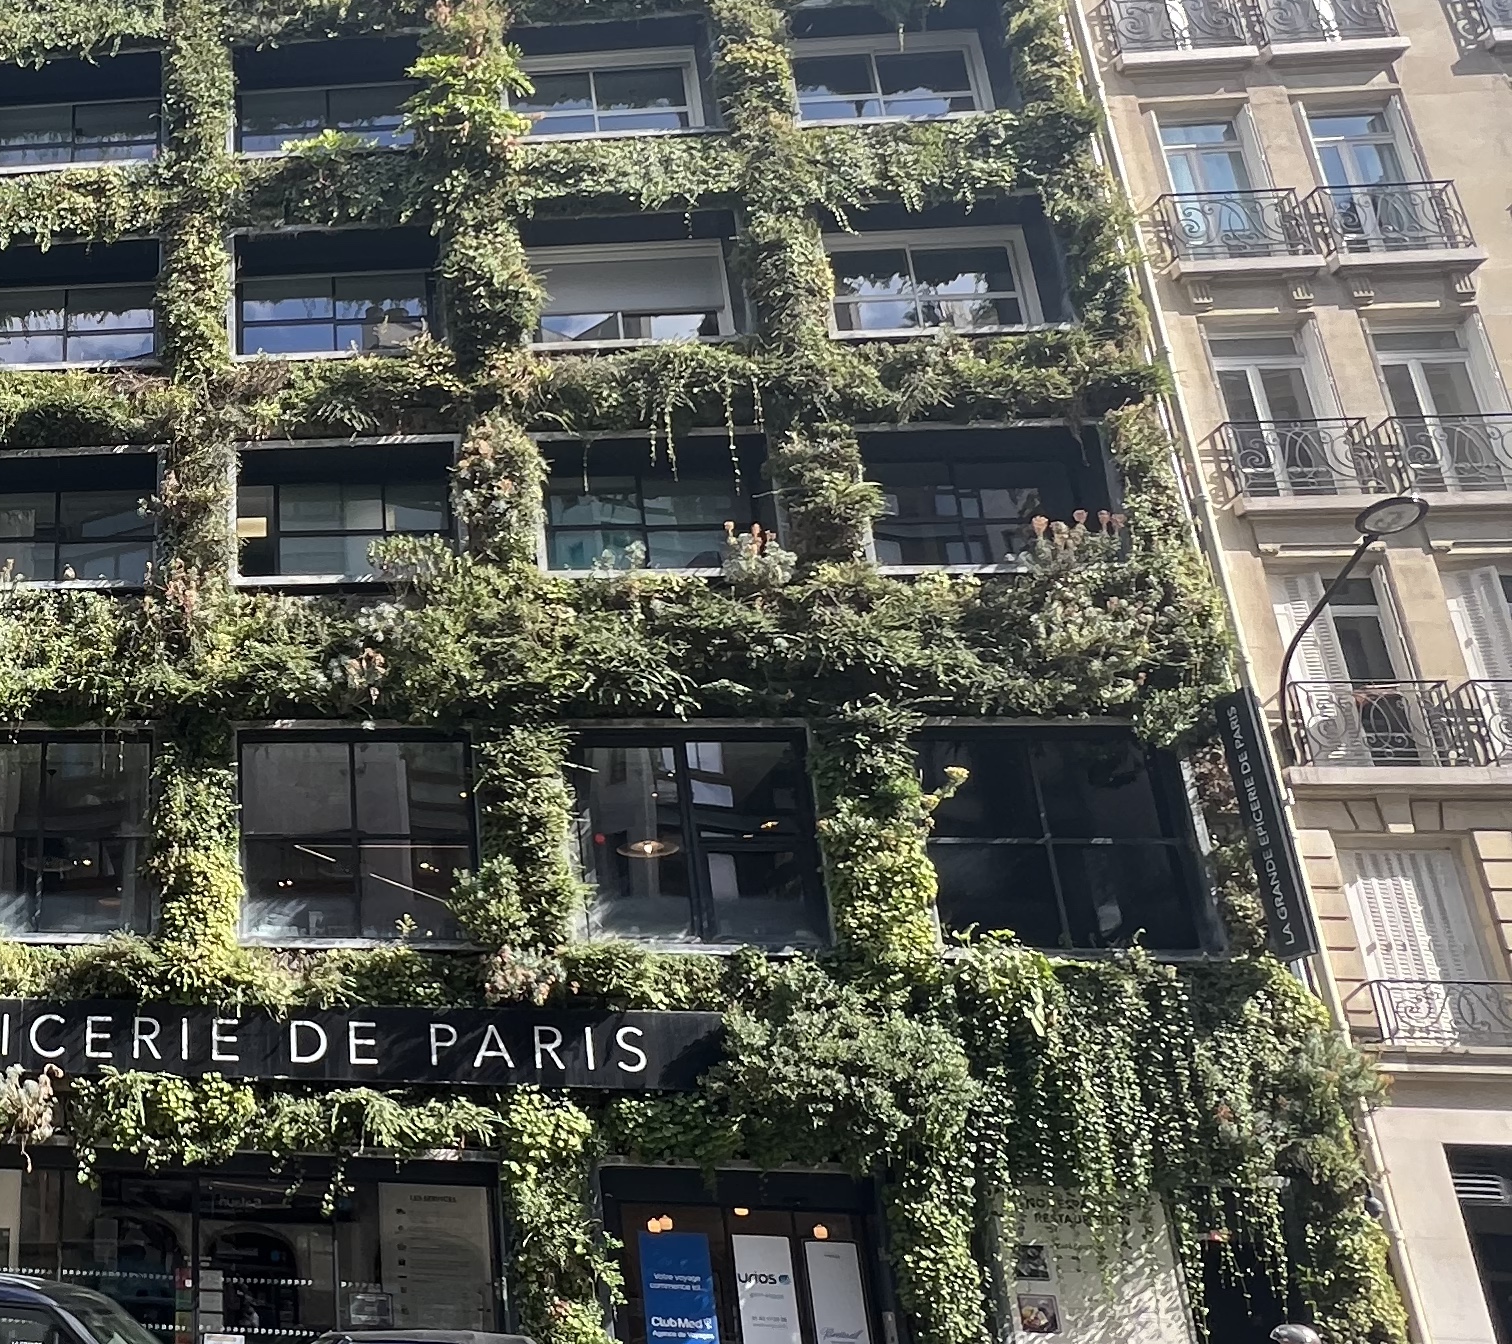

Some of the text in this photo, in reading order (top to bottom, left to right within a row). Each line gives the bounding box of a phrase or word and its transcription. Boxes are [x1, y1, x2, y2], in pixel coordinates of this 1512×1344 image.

[1227, 706, 1295, 945] LA GRANDE EPICERIE DE PARIS
[289, 1020, 379, 1065] DE
[429, 1022, 648, 1073] PARIS
